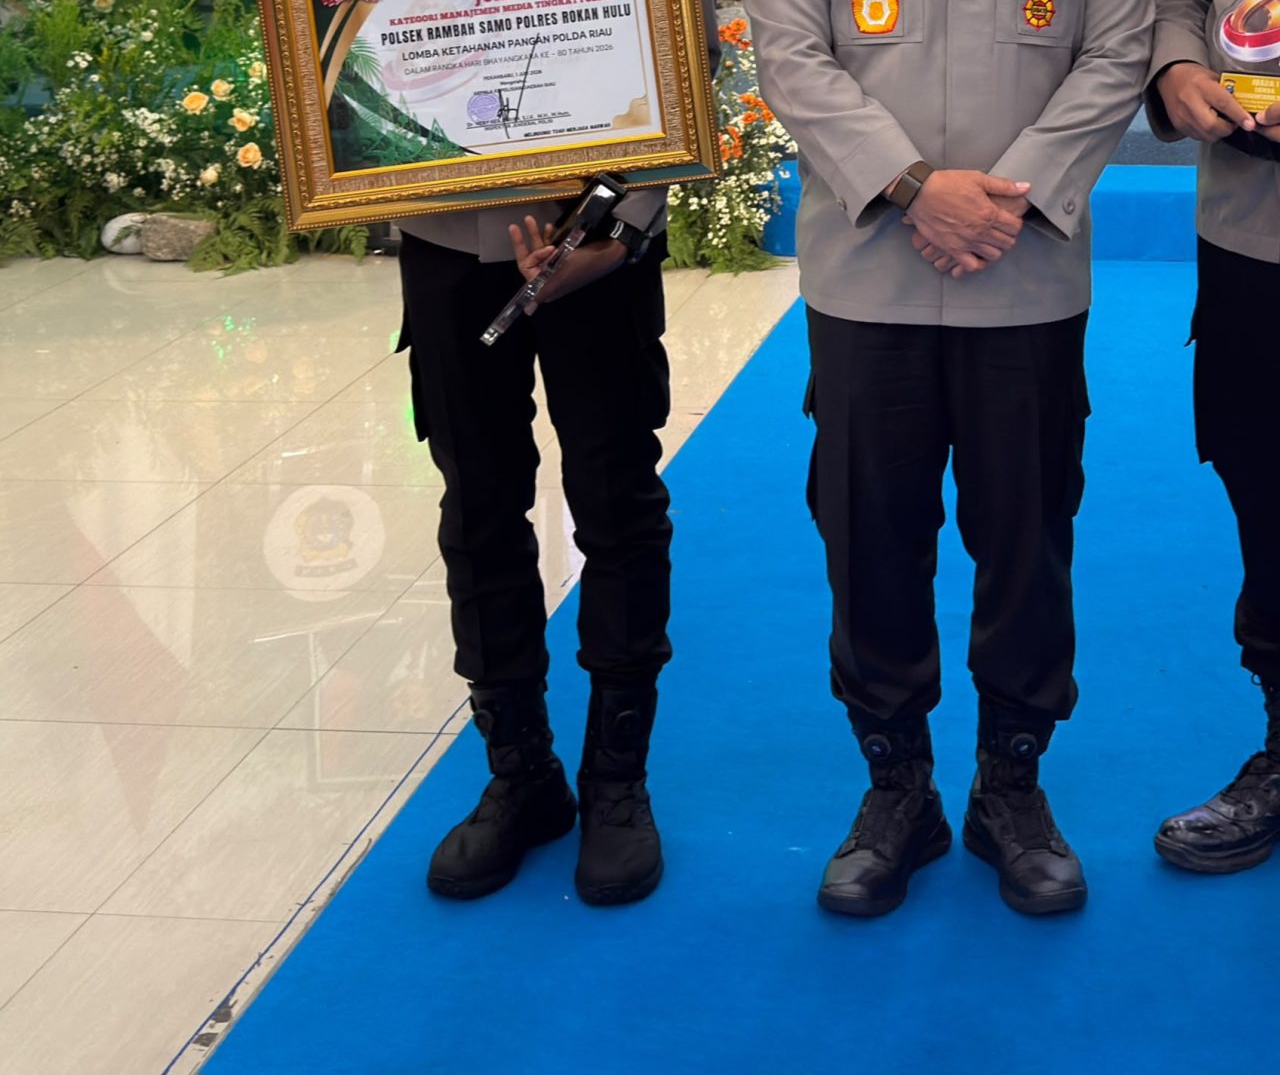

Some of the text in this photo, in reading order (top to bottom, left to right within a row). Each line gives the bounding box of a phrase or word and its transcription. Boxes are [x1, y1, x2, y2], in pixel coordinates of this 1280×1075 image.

[381, 2, 631, 46] POLSEK RAMBAH SAMO POLRES ROKAN HULU
[389, 13, 439, 26] KATEGORI
[440, 5, 501, 20] MANAJEMEN
[502, 2, 534, 13] MEDIA
[402, 27, 613, 62] LOMBA KETAHANAN PANGAN POLDA RIAU
